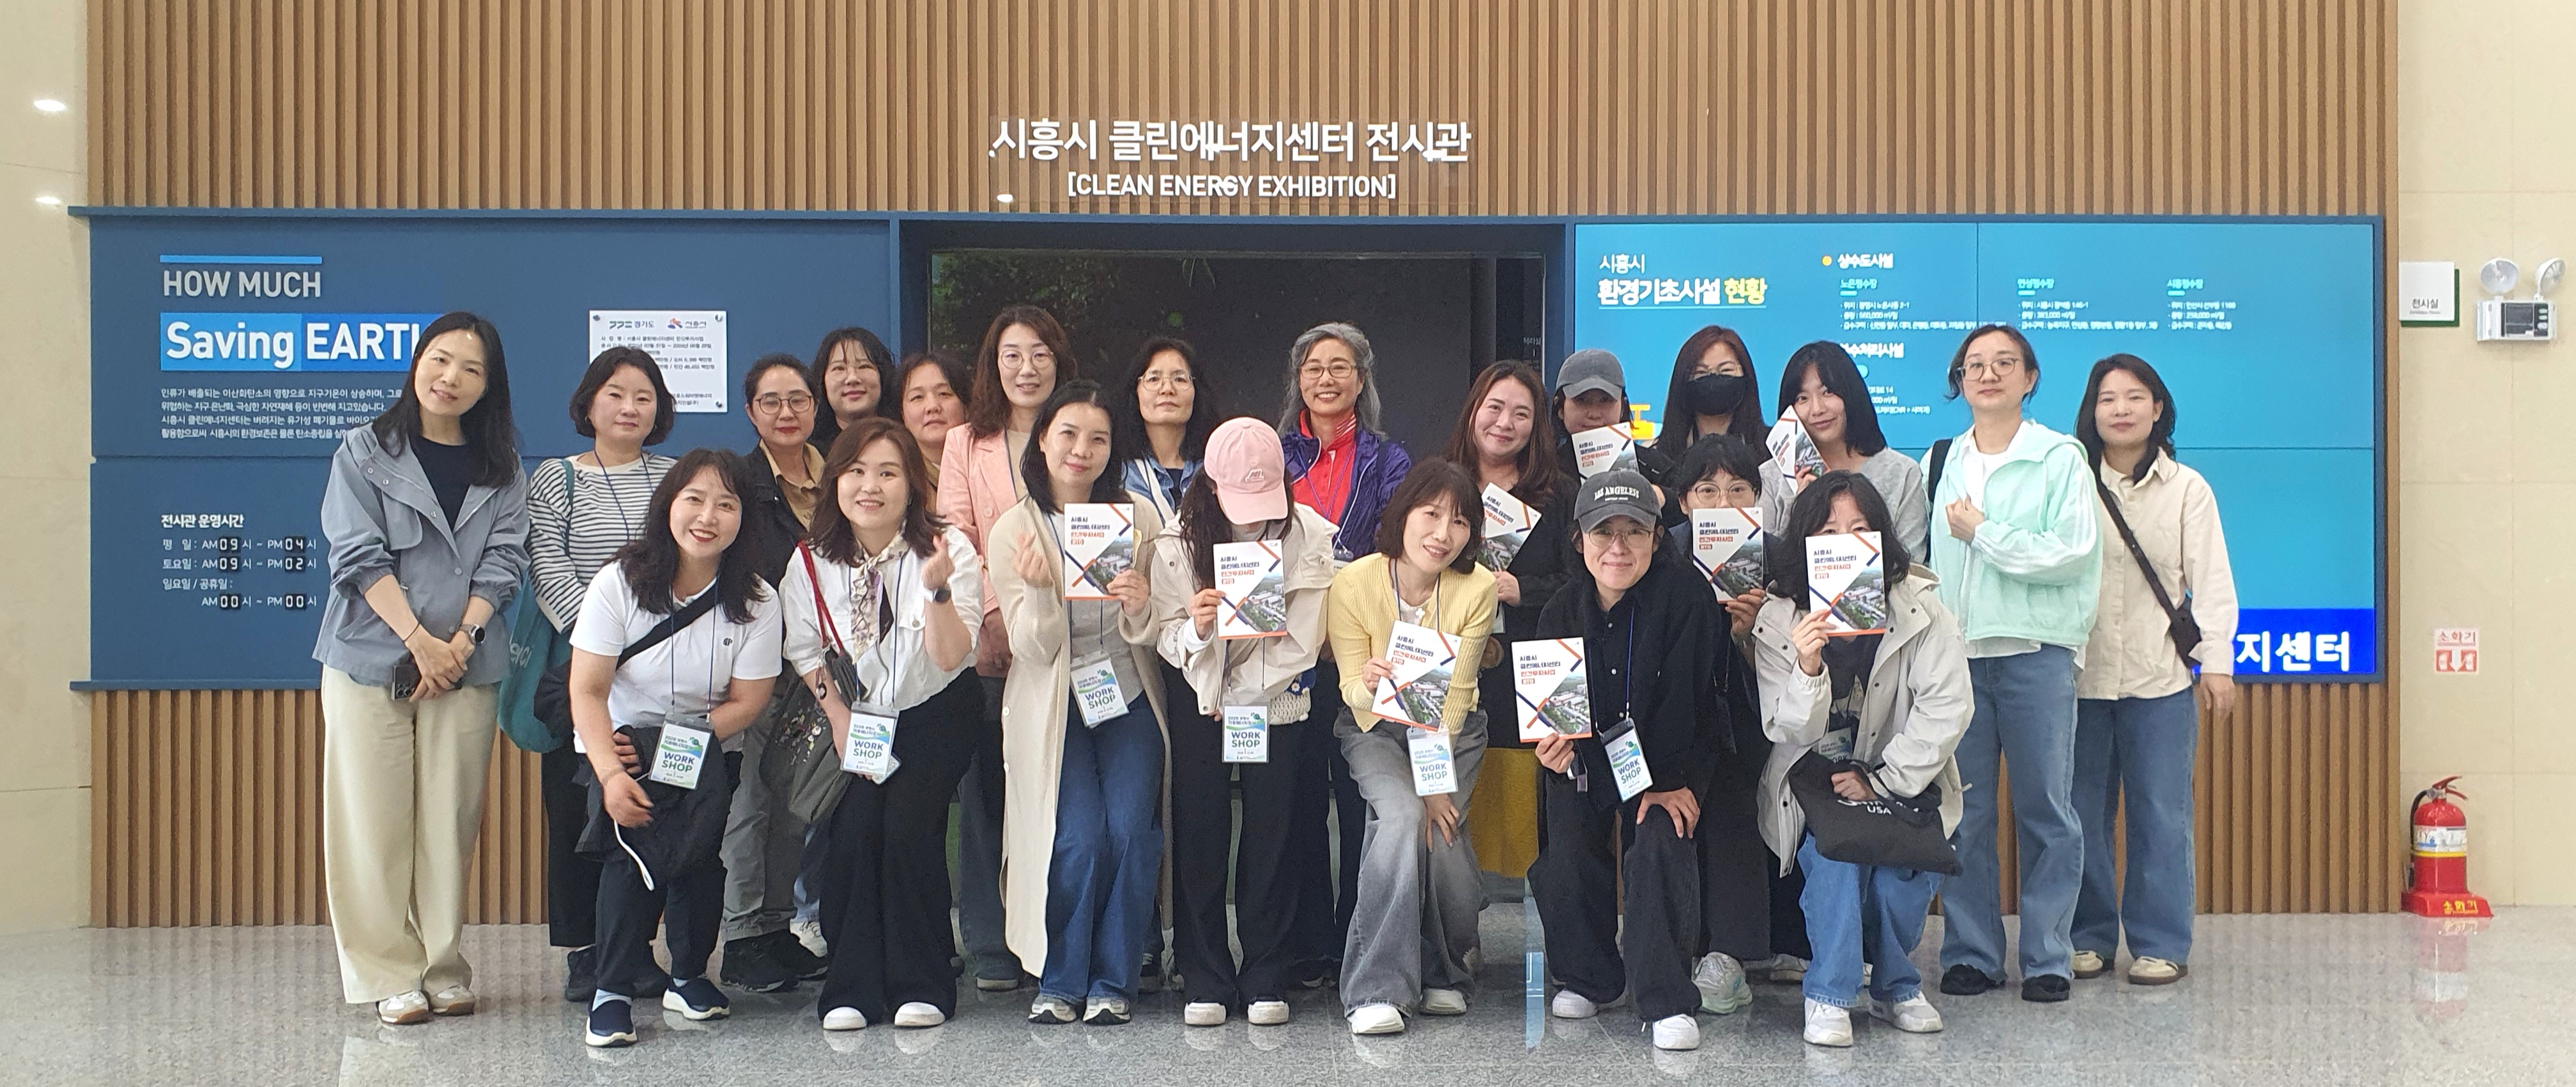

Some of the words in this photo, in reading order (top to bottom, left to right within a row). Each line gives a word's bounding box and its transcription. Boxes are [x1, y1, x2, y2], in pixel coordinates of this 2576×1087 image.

[992, 118, 1096, 160] 시흥시
[1108, 120, 1353, 162] 클린에너지센터
[1366, 121, 1472, 162] 전시관
[1068, 171, 1153, 197] [CLEAN
[1160, 174, 1254, 197] ENERGY
[1259, 174, 1397, 199] EXHIBITION]
[1599, 254, 1645, 274] 시흥시
[1837, 253, 1894, 269] 상수도시설
[164, 270, 231, 297] HOW
[238, 271, 321, 298] MUCH
[1597, 278, 1721, 305] 환경기초시설
[1724, 277, 1768, 305] 현황
[166, 321, 294, 369] Saving
[161, 388, 185, 399] 인류가
[188, 388, 221, 399] 배출되는
[222, 388, 272, 399] 이산화탄소의
[273, 388, 306, 399] 영향으로
[308, 388, 348, 399] 지구기온이
[350, 388, 385, 399] 상승하며,
[194, 402, 210, 413] 지구
[236, 402, 260, 413] 극심한
[261, 402, 293, 413] 자연재해
[295, 402, 311, 413] 등이
[337, 401, 387, 413] 지고있습니다.
[161, 415, 185, 425] 시흥시
[188, 415, 252, 425] 클린에너지센터는
[253, 415, 286, 426] 버려지는
[287, 415, 311, 426] 유기성
[346, 415, 372, 425] 바이오
[210, 428, 240, 439] 시흥시의
[1594, 487, 1604, 501] LOS
[161, 513, 197, 528] 전시관
[198, 513, 245, 528] 운영시간
[163, 538, 172, 551] 평
[181, 538, 192, 551] 일
[201, 539, 218, 549] AM
[241, 538, 252, 550] 시
[267, 539, 283, 549] PM
[307, 538, 317, 550] 시
[162, 558, 192, 570] 토요일
[201, 559, 218, 569] AM
[242, 558, 252, 570] 시
[267, 558, 283, 569] PM
[307, 558, 317, 570] 시
[201, 597, 218, 606] AM
[241, 595, 252, 607] 시
[267, 596, 282, 606] PM
[307, 595, 317, 607] 시
[2437, 630, 2476, 646] 소화기
[1084, 686, 1115, 701] WORK
[1088, 694, 1116, 710] SHOP
[1230, 731, 1261, 740] WORK
[854, 740, 884, 751] WORK
[1231, 740, 1261, 748] SHOP
[664, 752, 695, 765] WORK
[853, 748, 882, 759] SHOP
[661, 759, 693, 773] SHOP
[1419, 763, 1448, 773] WORK
[1618, 758, 1640, 775] WORK
[1422, 770, 1448, 782] SHOP
[1621, 766, 1641, 784] SHOP
[1867, 805, 1892, 815] USA
[2443, 899, 2479, 915] 소화기
